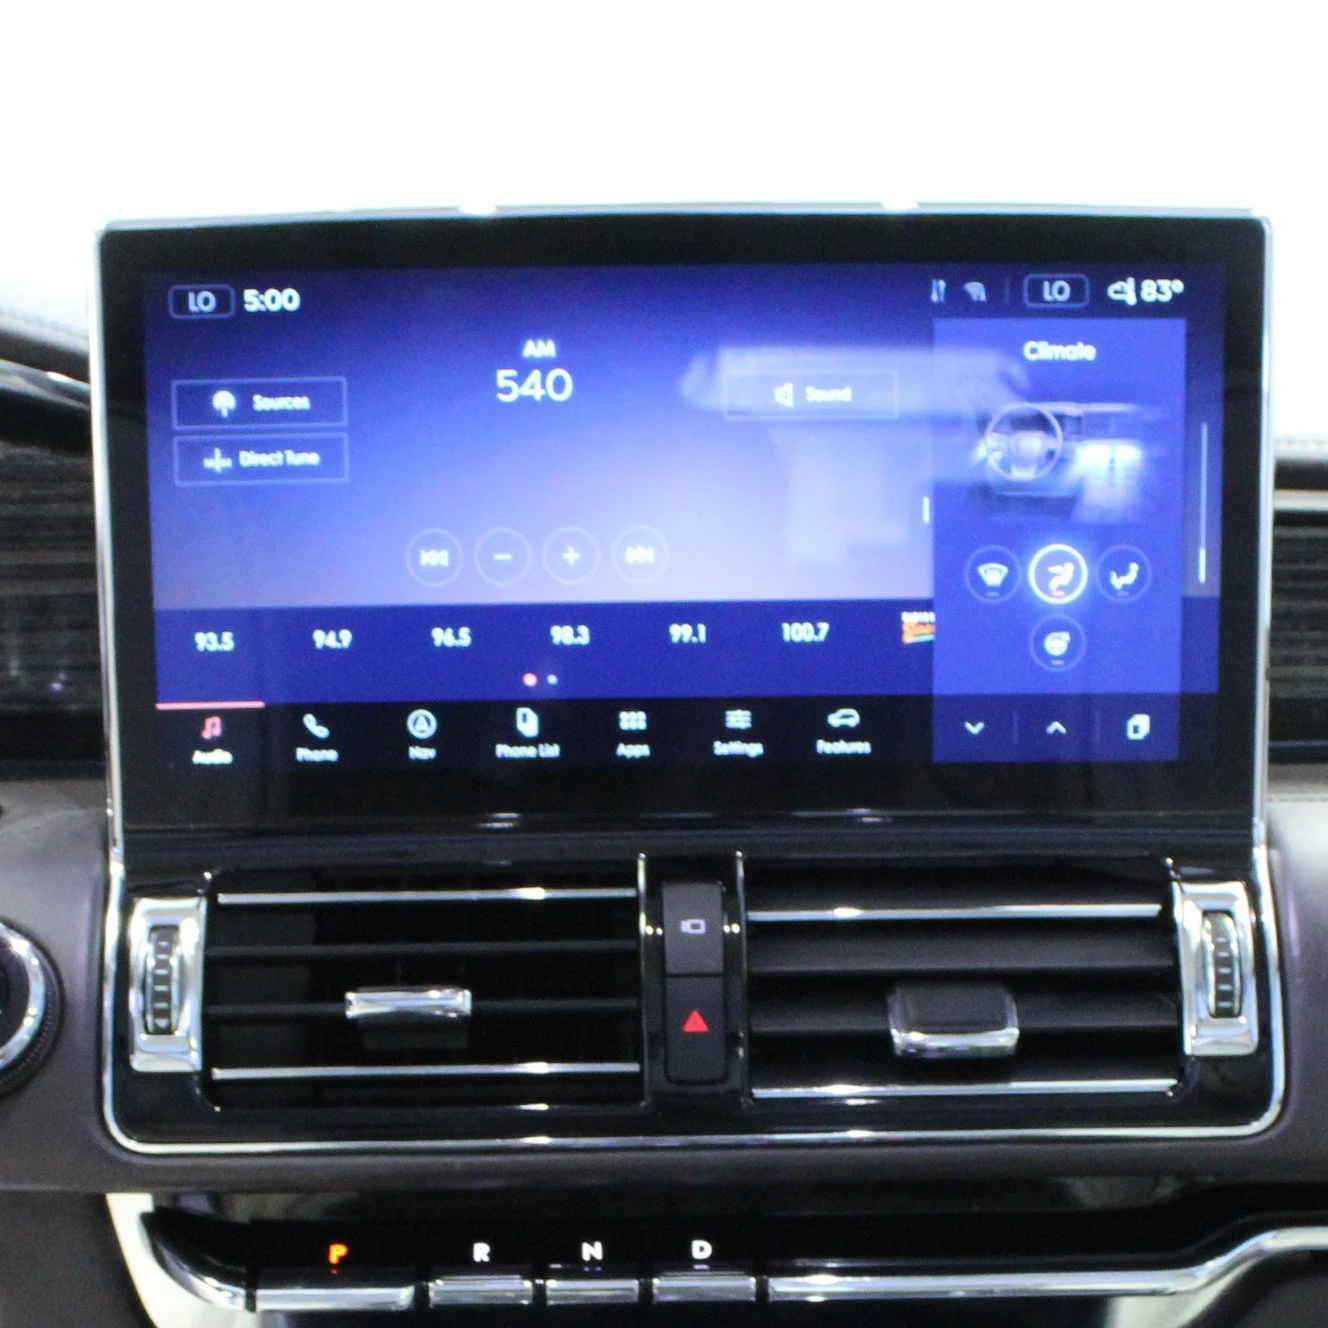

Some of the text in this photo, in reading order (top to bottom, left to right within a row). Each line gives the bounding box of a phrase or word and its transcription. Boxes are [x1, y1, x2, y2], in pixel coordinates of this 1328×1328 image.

[244, 288, 300, 311] 5:00
[1043, 280, 1070, 301] LO
[189, 291, 215, 312] LO
[523, 340, 556, 358] AM
[1024, 341, 1096, 360] Climate
[497, 368, 573, 402] 540
[806, 386, 852, 402] Sound
[253, 394, 310, 410] Sources
[239, 450, 320, 466] Direct Tune
[195, 632, 234, 651] 93.5
[313, 629, 352, 648] 94.9
[432, 627, 471, 647] 96.5
[551, 625, 590, 645] 98.3
[669, 624, 706, 643] 99.1
[782, 622, 829, 642] 100.7
[192, 749, 232, 764] Audio
[296, 747, 338, 761] Phone
[409, 746, 436, 759] Nav
[496, 743, 560, 757] Phone List
[617, 743, 650, 758] Apps
[714, 741, 763, 757] Settings
[817, 740, 871, 754] Features
[328, 1244, 348, 1264] P
[473, 1243, 490, 1262] R
[582, 1241, 602, 1261] N
[692, 1240, 712, 1259] D
